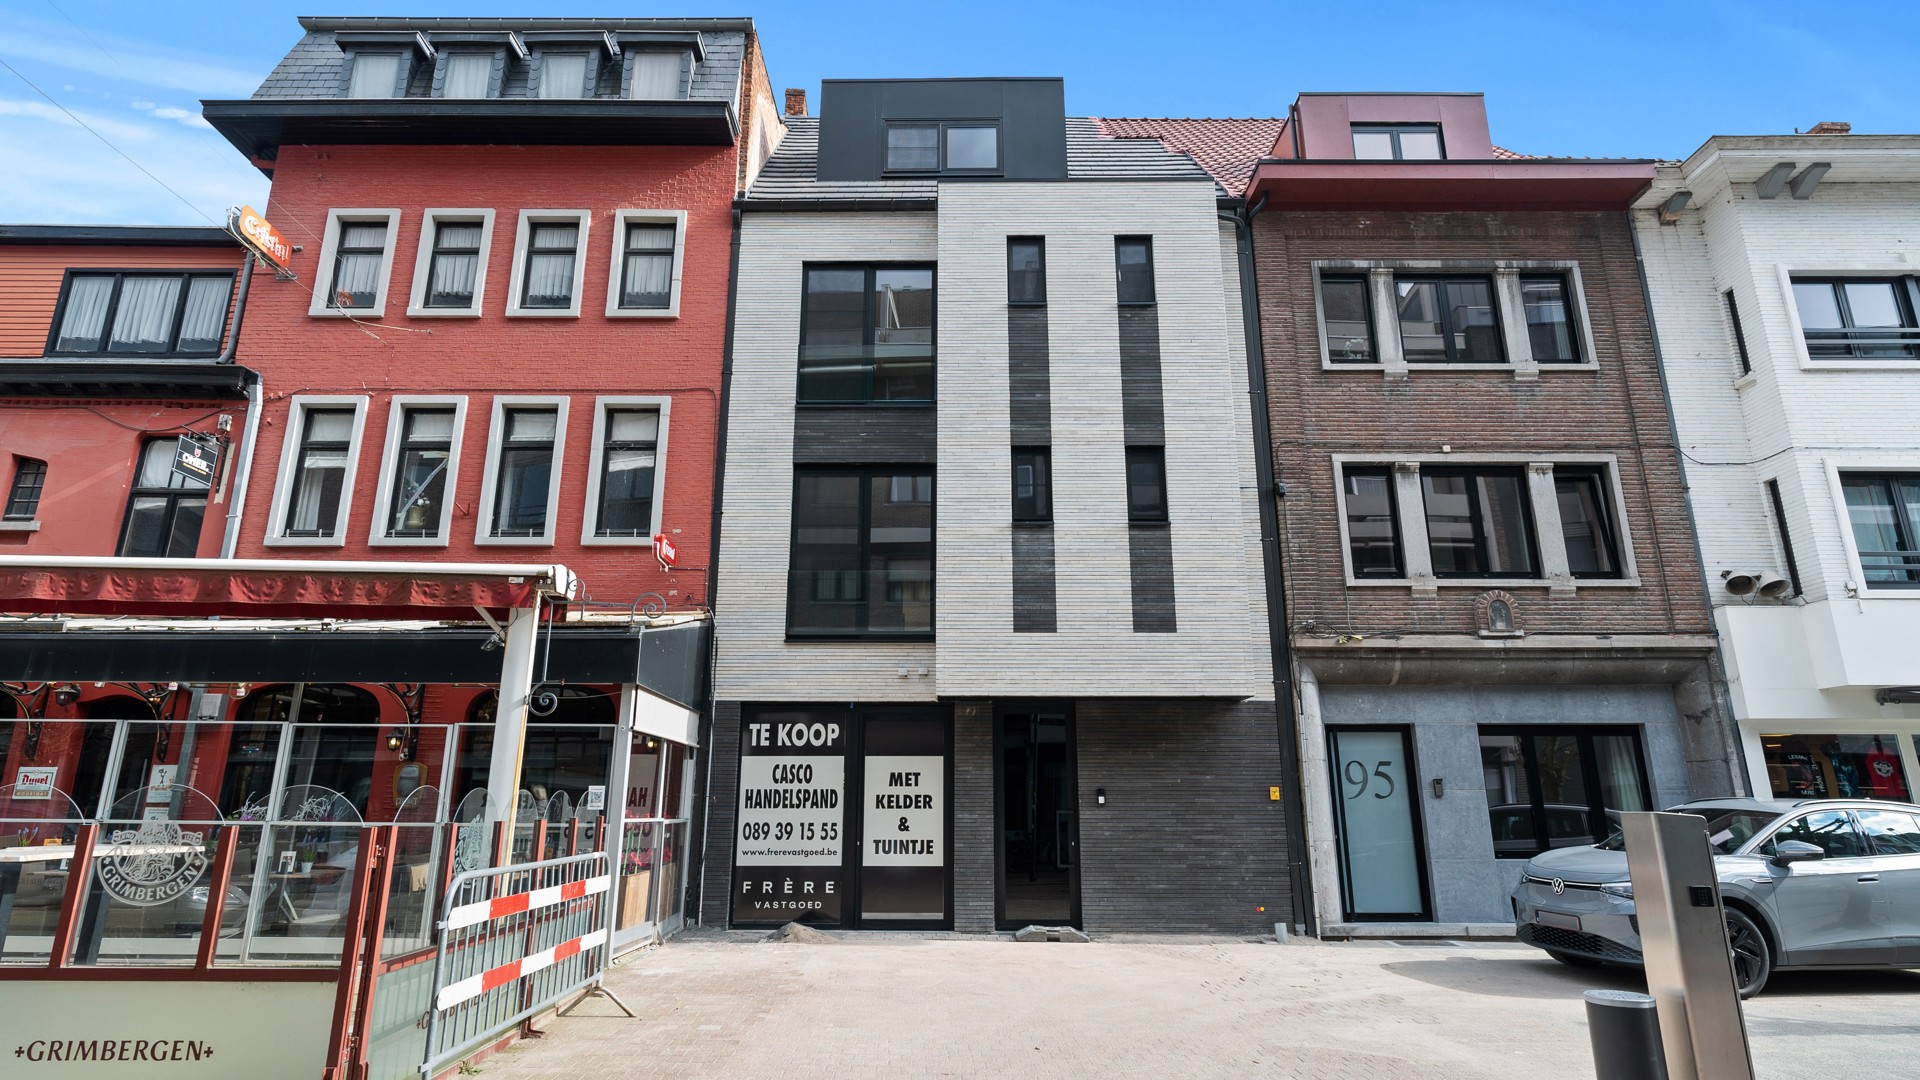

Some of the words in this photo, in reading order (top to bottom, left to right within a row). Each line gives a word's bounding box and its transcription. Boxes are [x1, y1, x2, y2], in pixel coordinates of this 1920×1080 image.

[749, 723, 770, 746] TE
[778, 722, 840, 747] KOOP
[772, 763, 813, 784] CASCO
[888, 772, 921, 787] MET
[1344, 760, 1394, 799] 95
[744, 788, 838, 809] HANDELSPAND
[875, 794, 933, 809] KELDER
[742, 822, 769, 841] 089
[775, 822, 793, 840] 39
[800, 822, 815, 840] 15
[820, 822, 838, 840] 55
[897, 816, 910, 832] &
[741, 847, 838, 857] www.frerevastgoed.be
[873, 839, 934, 855] TUINTJE
[102, 865, 198, 901] GRIMBERGEN
[742, 878, 835, 894] FRÈRE
[754, 901, 822, 909] VASTGOED
[26, 1040, 204, 1062] GRIMBERGEN
